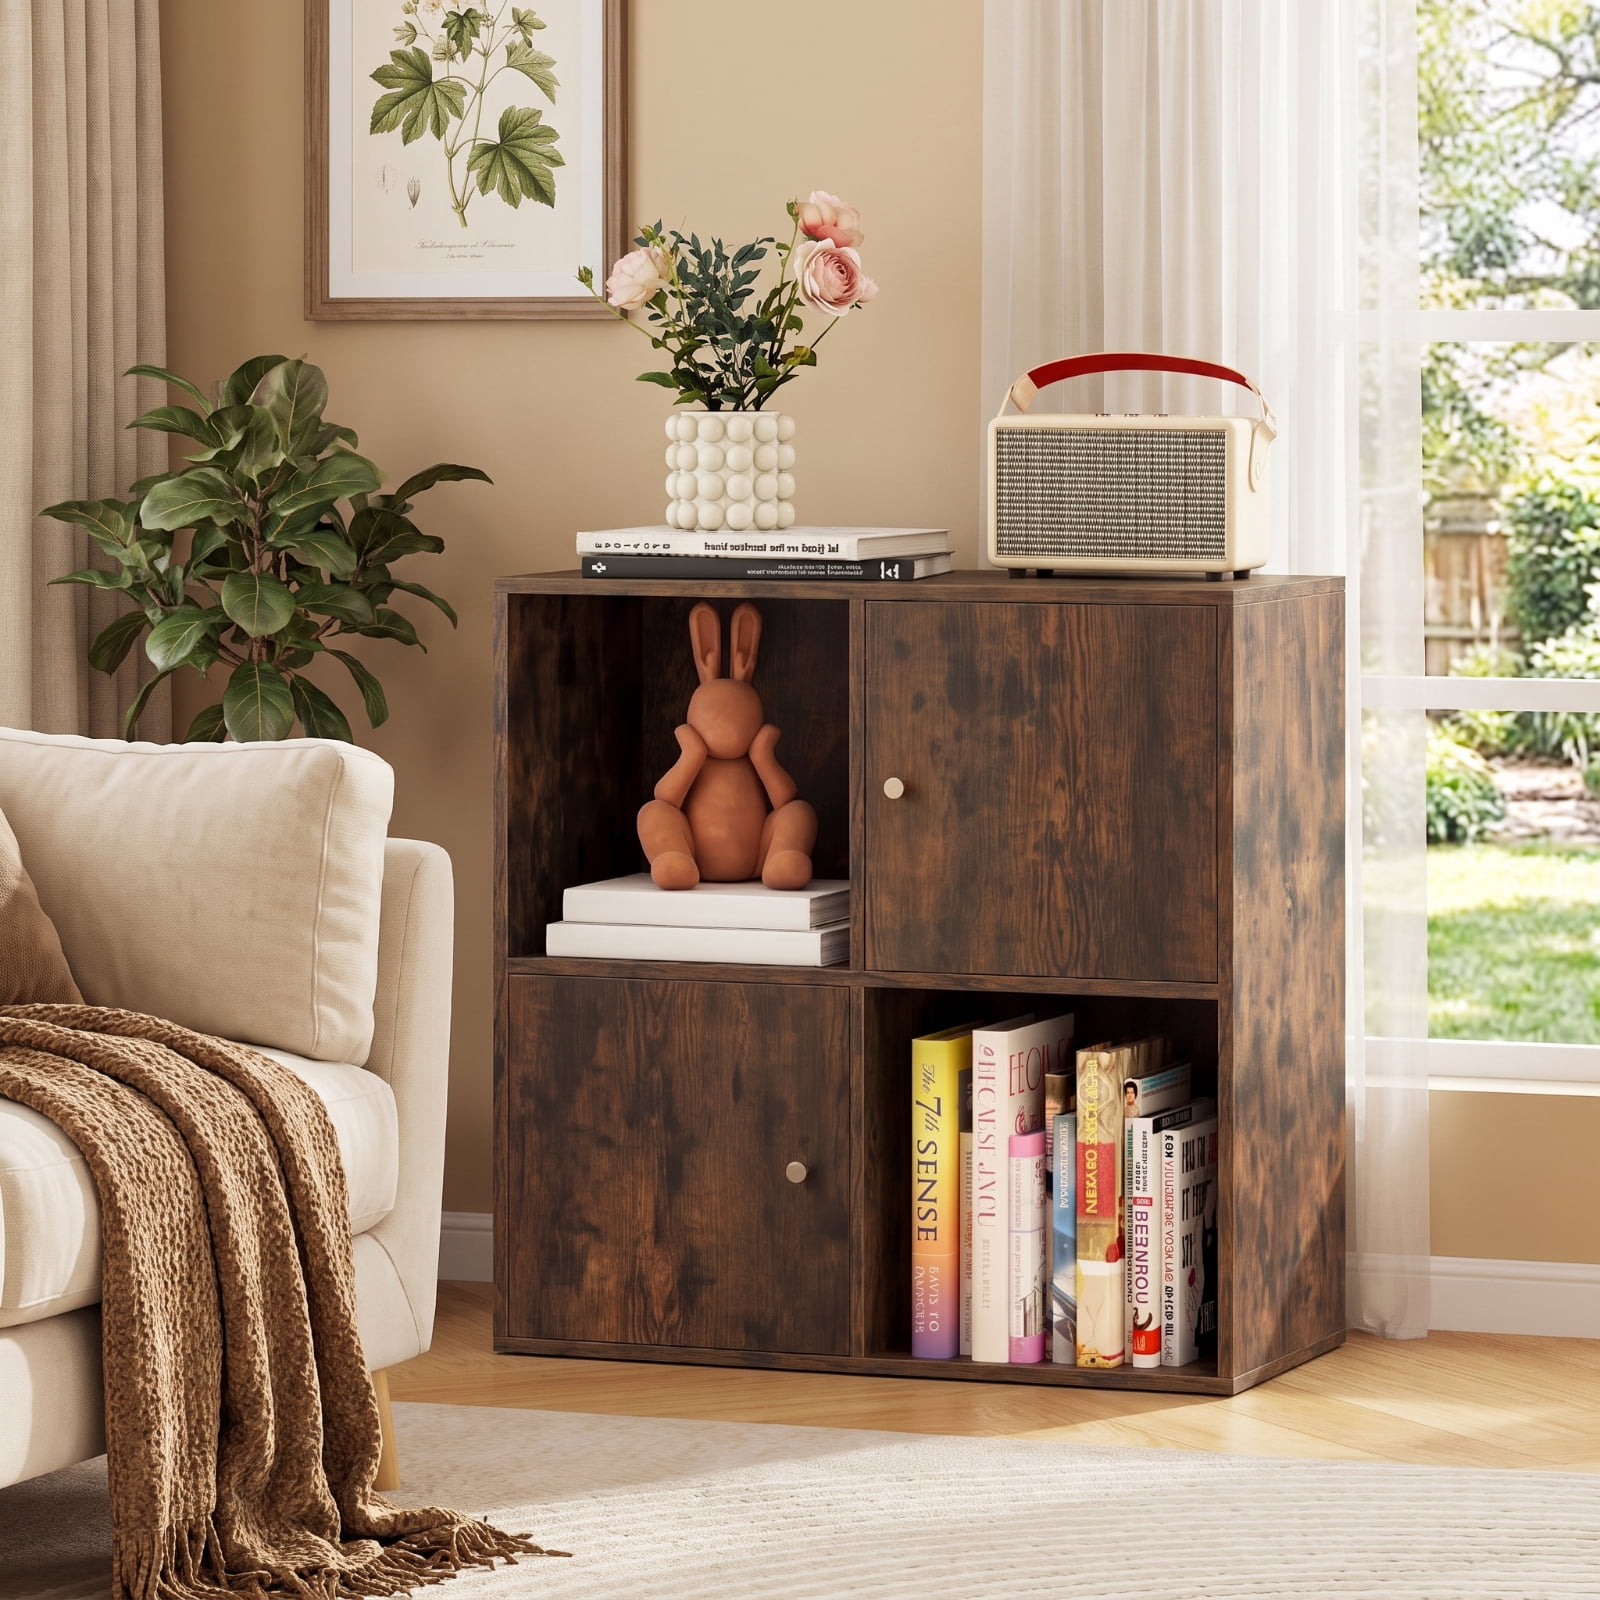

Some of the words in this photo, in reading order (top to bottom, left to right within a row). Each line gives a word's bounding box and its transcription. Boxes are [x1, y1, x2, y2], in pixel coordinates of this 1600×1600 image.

[922, 1063, 936, 1094] The
[915, 1096, 942, 1132] 7th
[916, 1139, 938, 1241] SENSE
